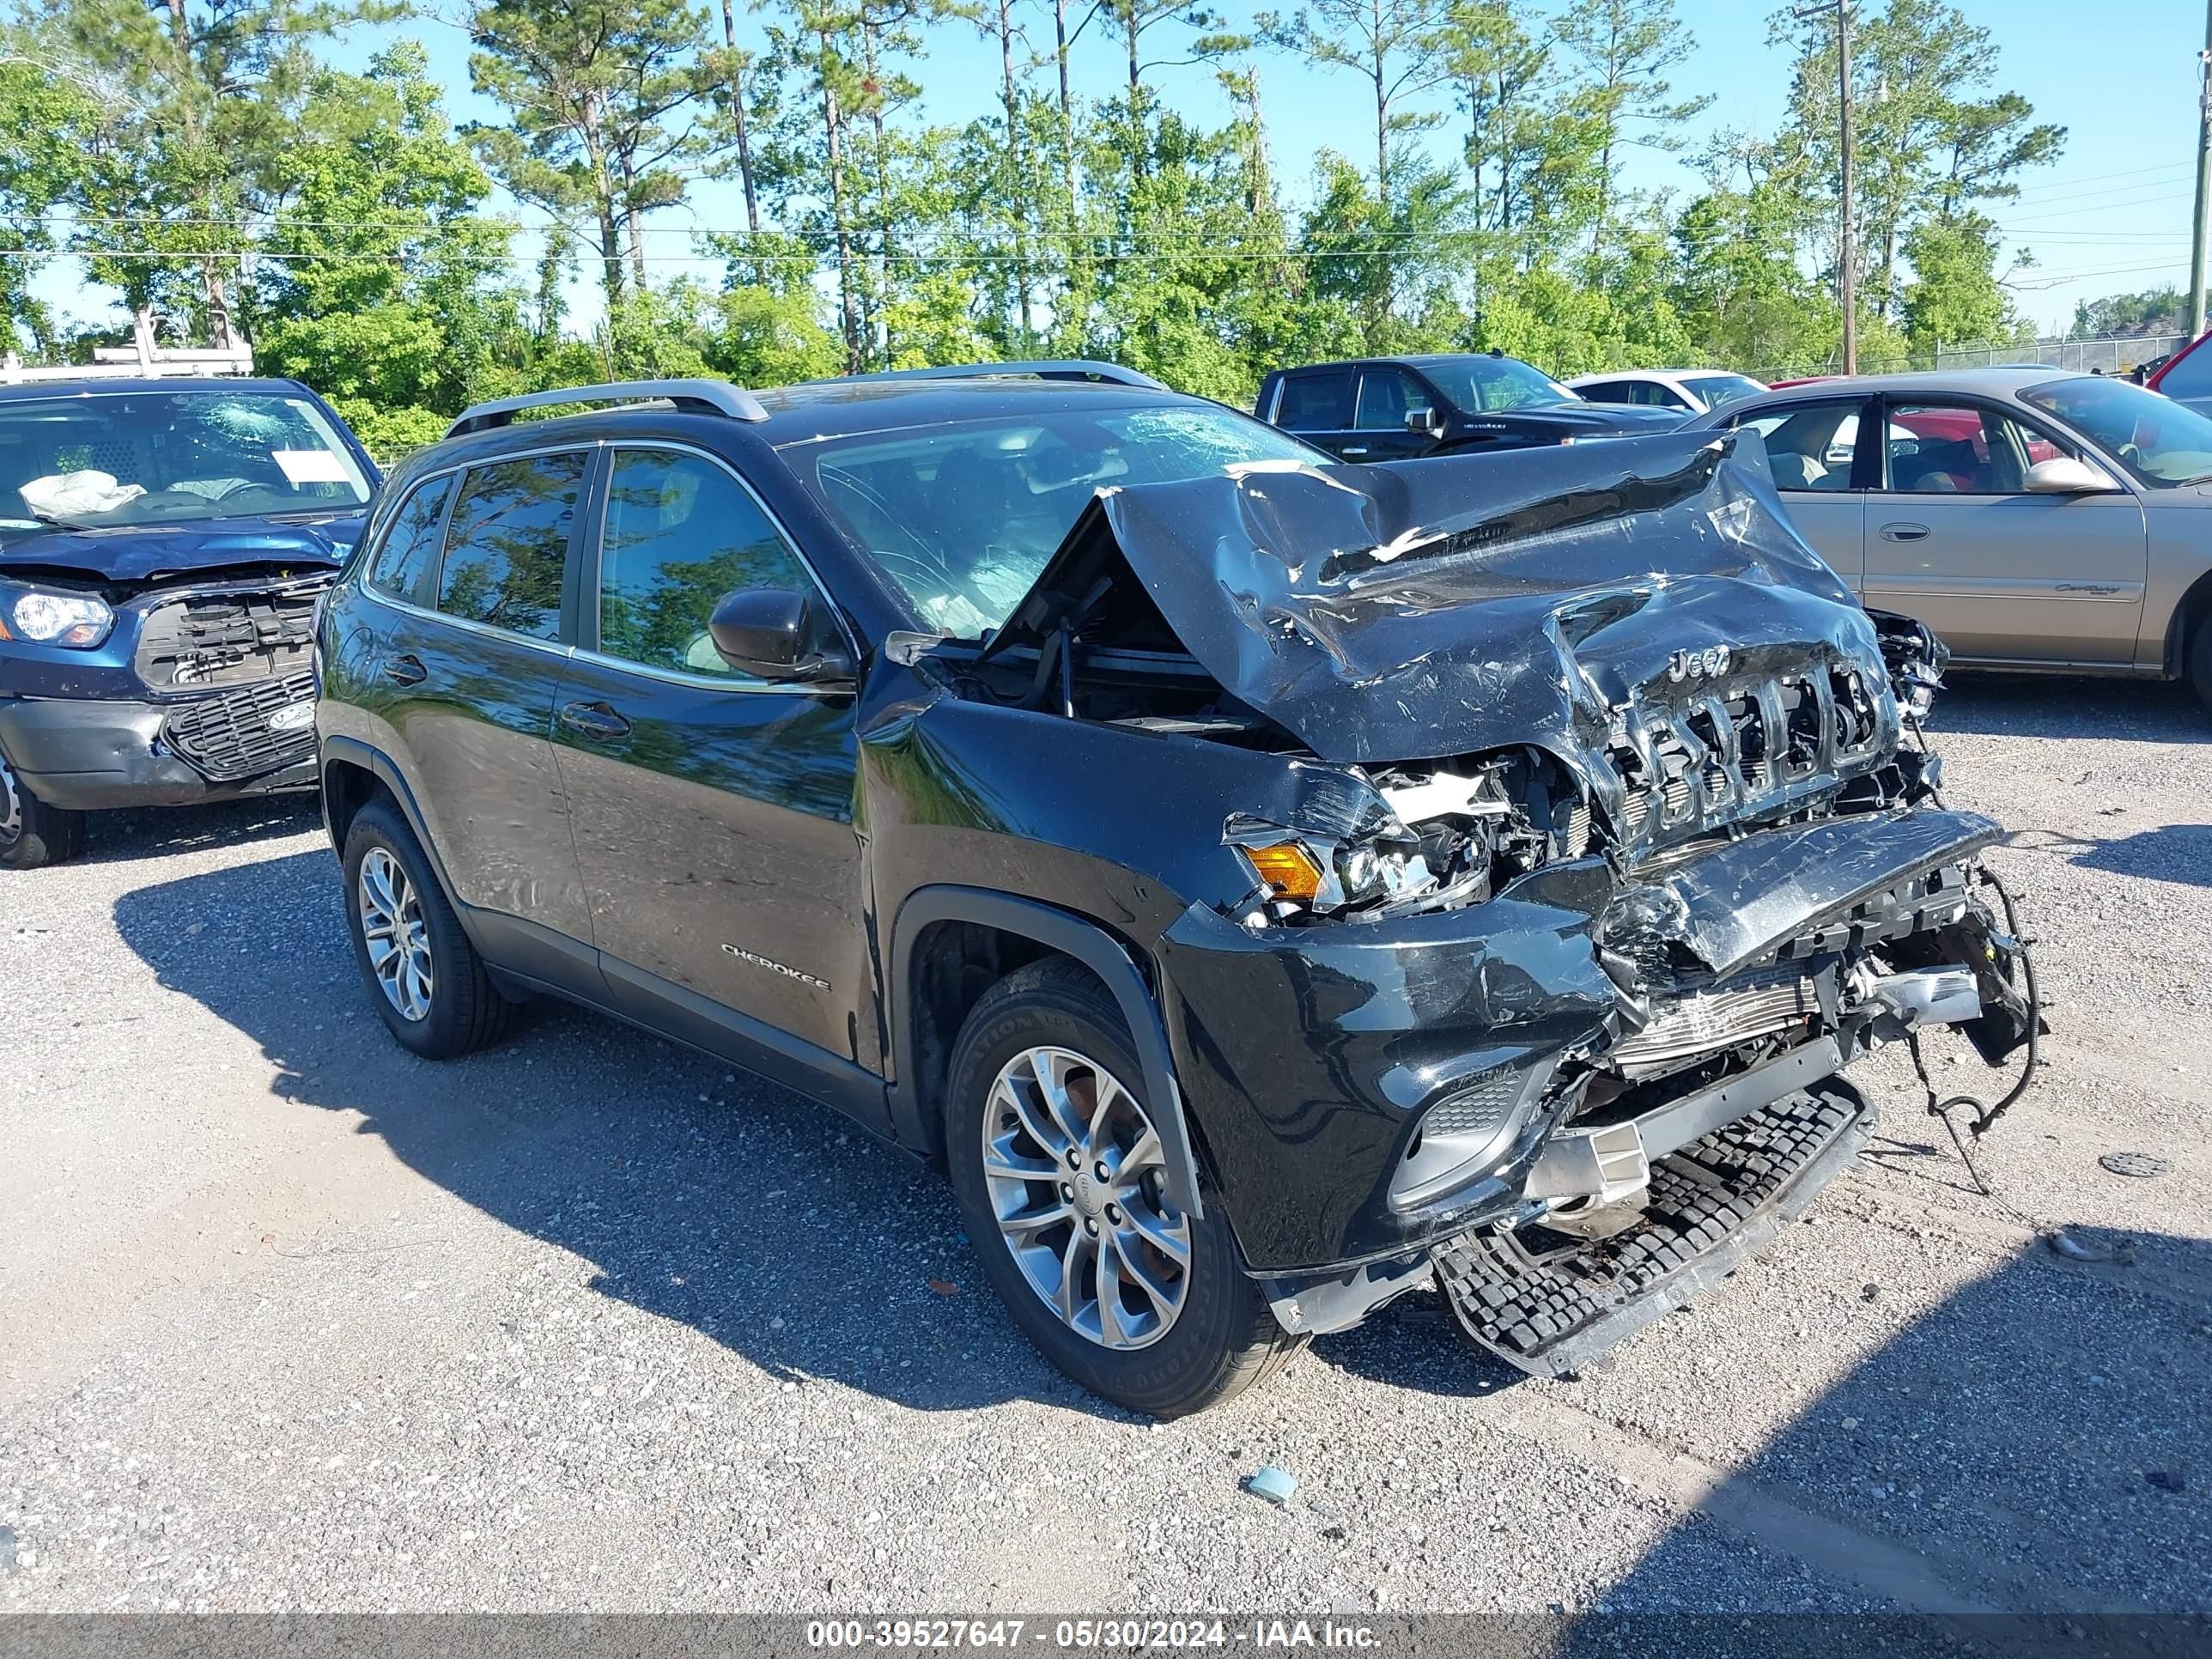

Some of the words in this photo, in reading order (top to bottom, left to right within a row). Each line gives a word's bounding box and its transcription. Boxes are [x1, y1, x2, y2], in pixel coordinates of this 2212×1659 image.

[2054, 583, 2121, 593] Century
[1668, 643, 1731, 683] Jeep
[720, 942, 832, 993] CHEROKEE
